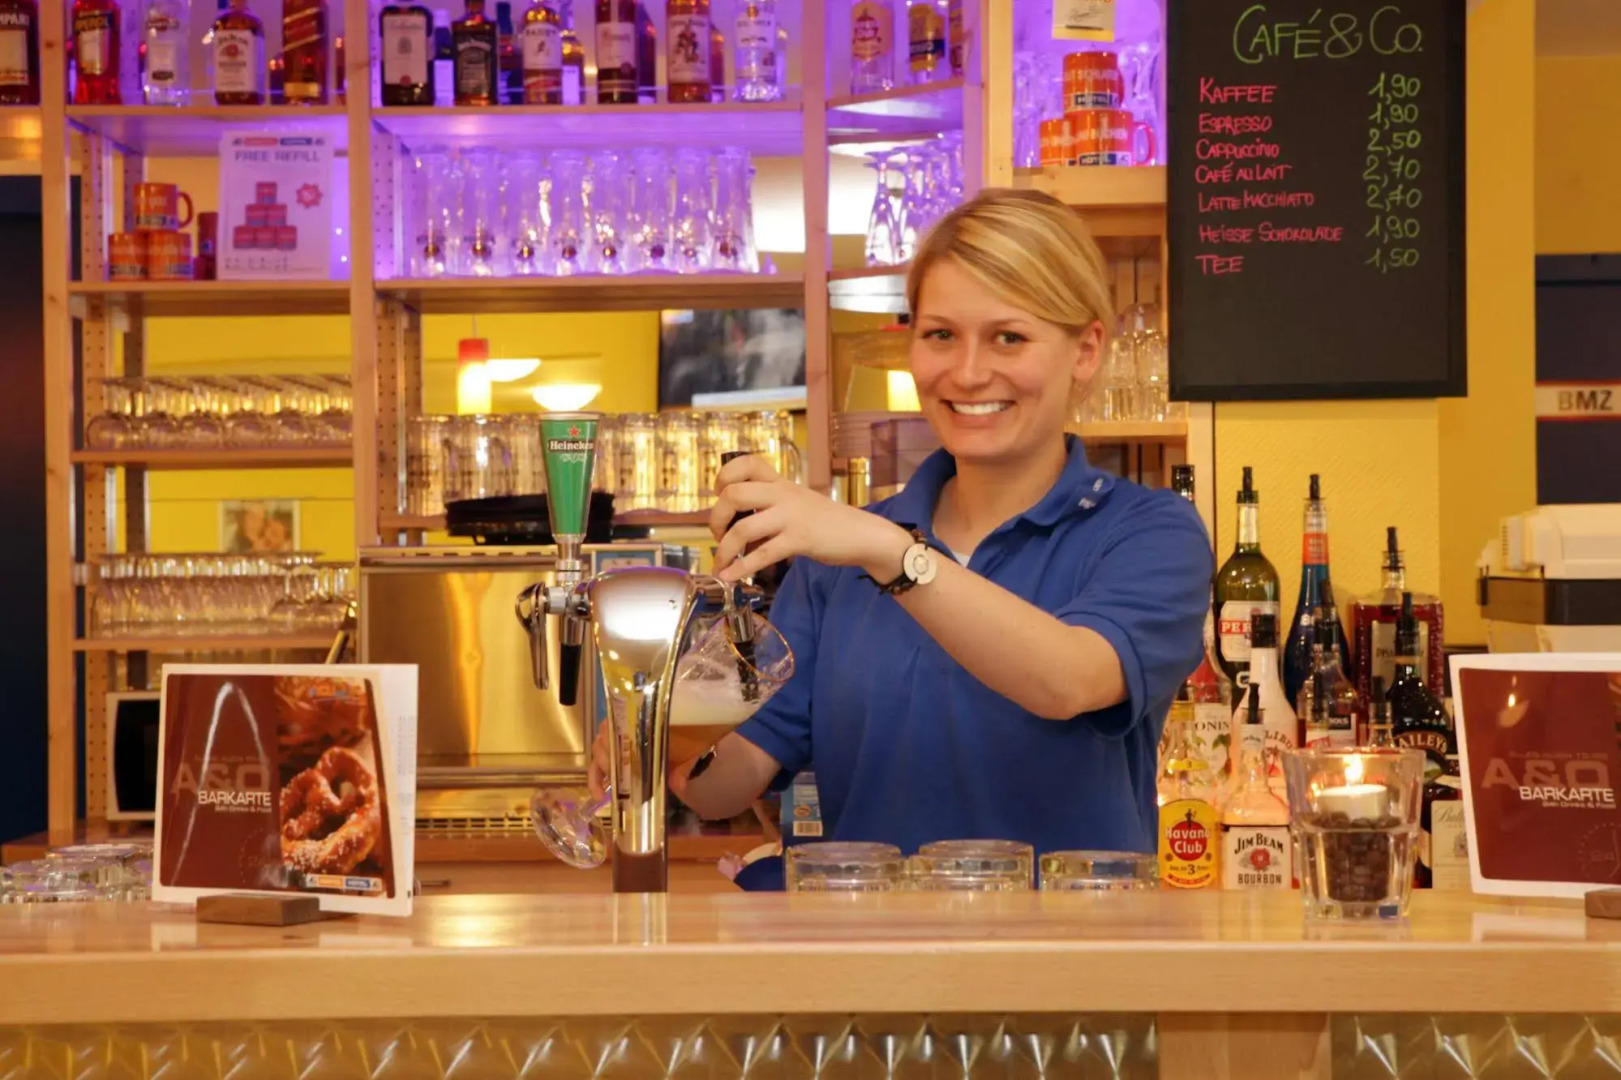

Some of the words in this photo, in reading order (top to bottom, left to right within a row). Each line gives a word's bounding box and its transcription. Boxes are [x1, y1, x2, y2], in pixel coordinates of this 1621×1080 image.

[1233, 5, 1322, 63] CAFÉ
[1324, 13, 1362, 58] &
[1200, 77, 1277, 103] KAFFEE
[1368, 72, 1421, 104] 1,90
[1199, 113, 1273, 135] ESPRESSO
[1368, 102, 1418, 130] 1,90
[1367, 128, 1421, 156] 2,50
[1195, 161, 1234, 184] CAFÉ
[1363, 154, 1421, 187] 2,70
[1199, 192, 1242, 212] LATTE
[1367, 184, 1422, 212] 2,70
[1259, 221, 1343, 242] SCHOKOLADE
[1365, 215, 1420, 244] 1,90
[1195, 254, 1244, 275] TEE
[1365, 248, 1419, 273] 1,50
[1221, 621, 1252, 633] PER
[1194, 720, 1230, 732] ONIN
[1398, 733, 1447, 753] AILEYS
[198, 790, 272, 807] BARKARTE
[1519, 786, 1615, 803] BARKARTE
[1165, 827, 1210, 840] Havana
[1234, 837, 1254, 854] JIM
[1256, 833, 1284, 852] BEAM
[1174, 841, 1203, 854] Club
[1187, 863, 1196, 876] 3
[1238, 873, 1282, 885] BOURBON
